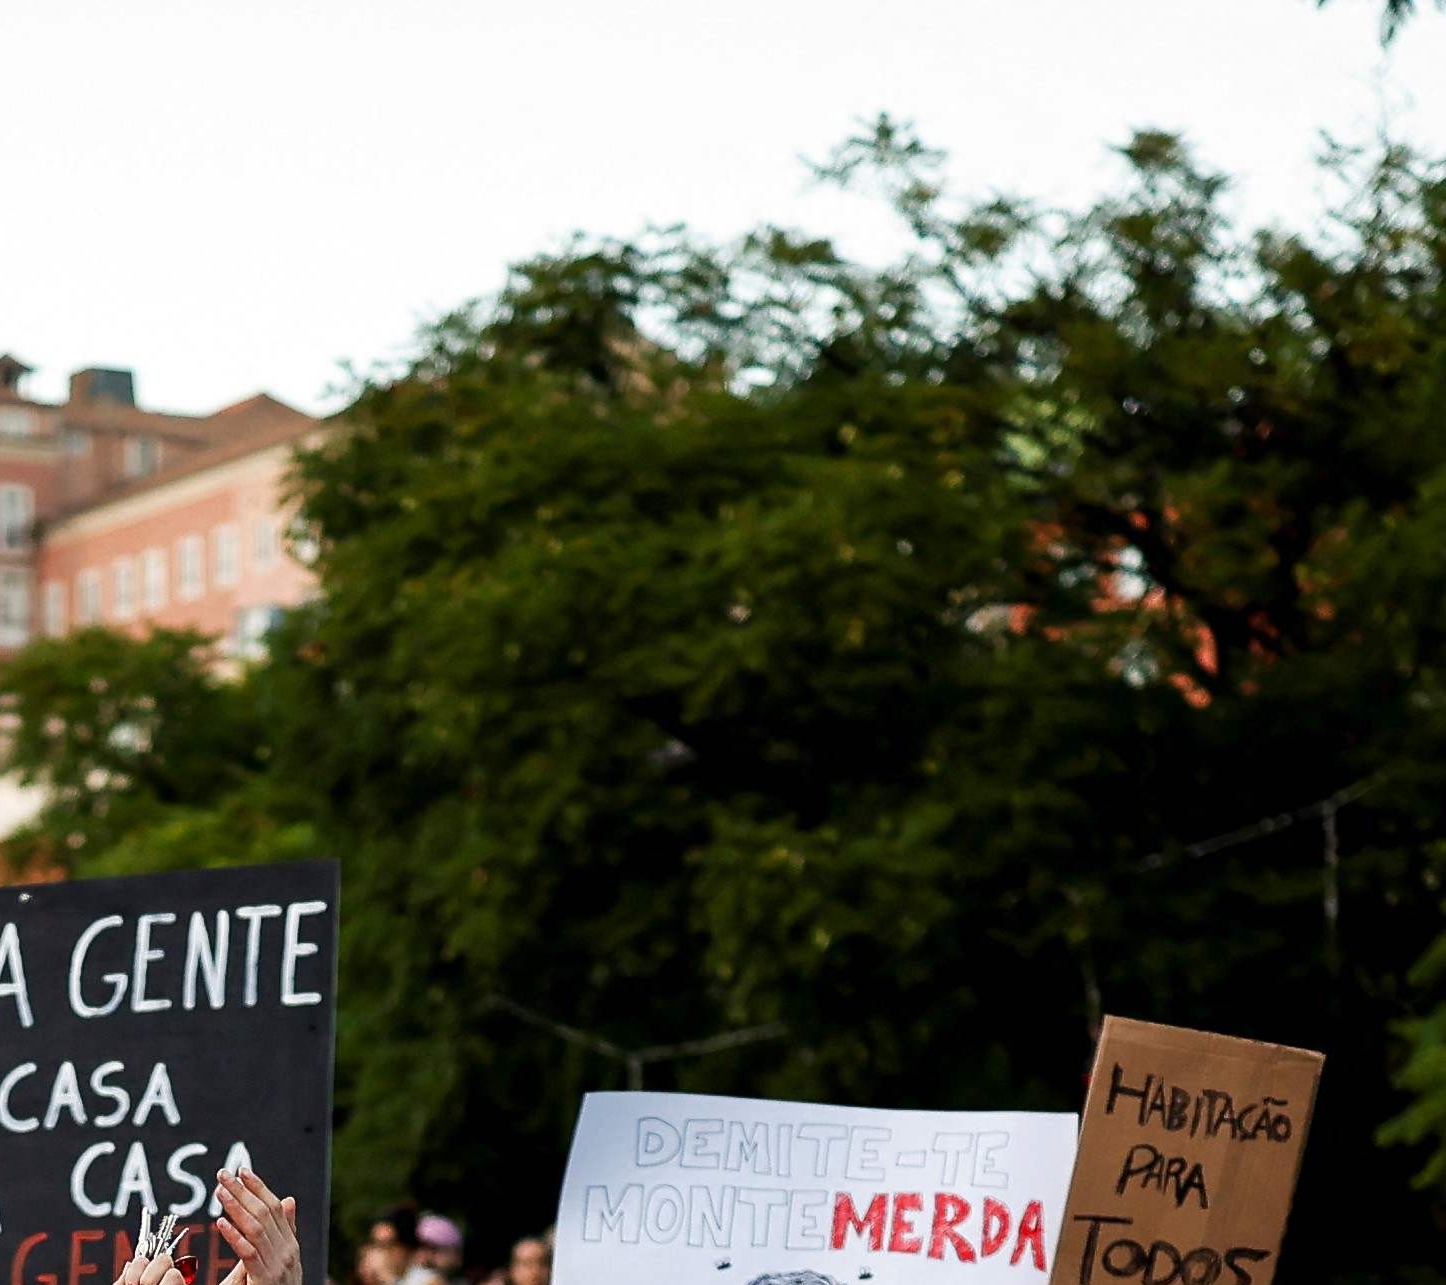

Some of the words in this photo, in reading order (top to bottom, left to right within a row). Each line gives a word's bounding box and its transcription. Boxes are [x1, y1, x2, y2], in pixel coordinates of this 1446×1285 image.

[68, 900, 328, 1019] GENTE
[1106, 1062, 1293, 1143] HABITAÇÃO
[636, 1115, 1011, 1189] DEMITE-TE
[1115, 1143, 1209, 1209] PARA
[581, 1182, 1048, 1273] MONTEMERDA
